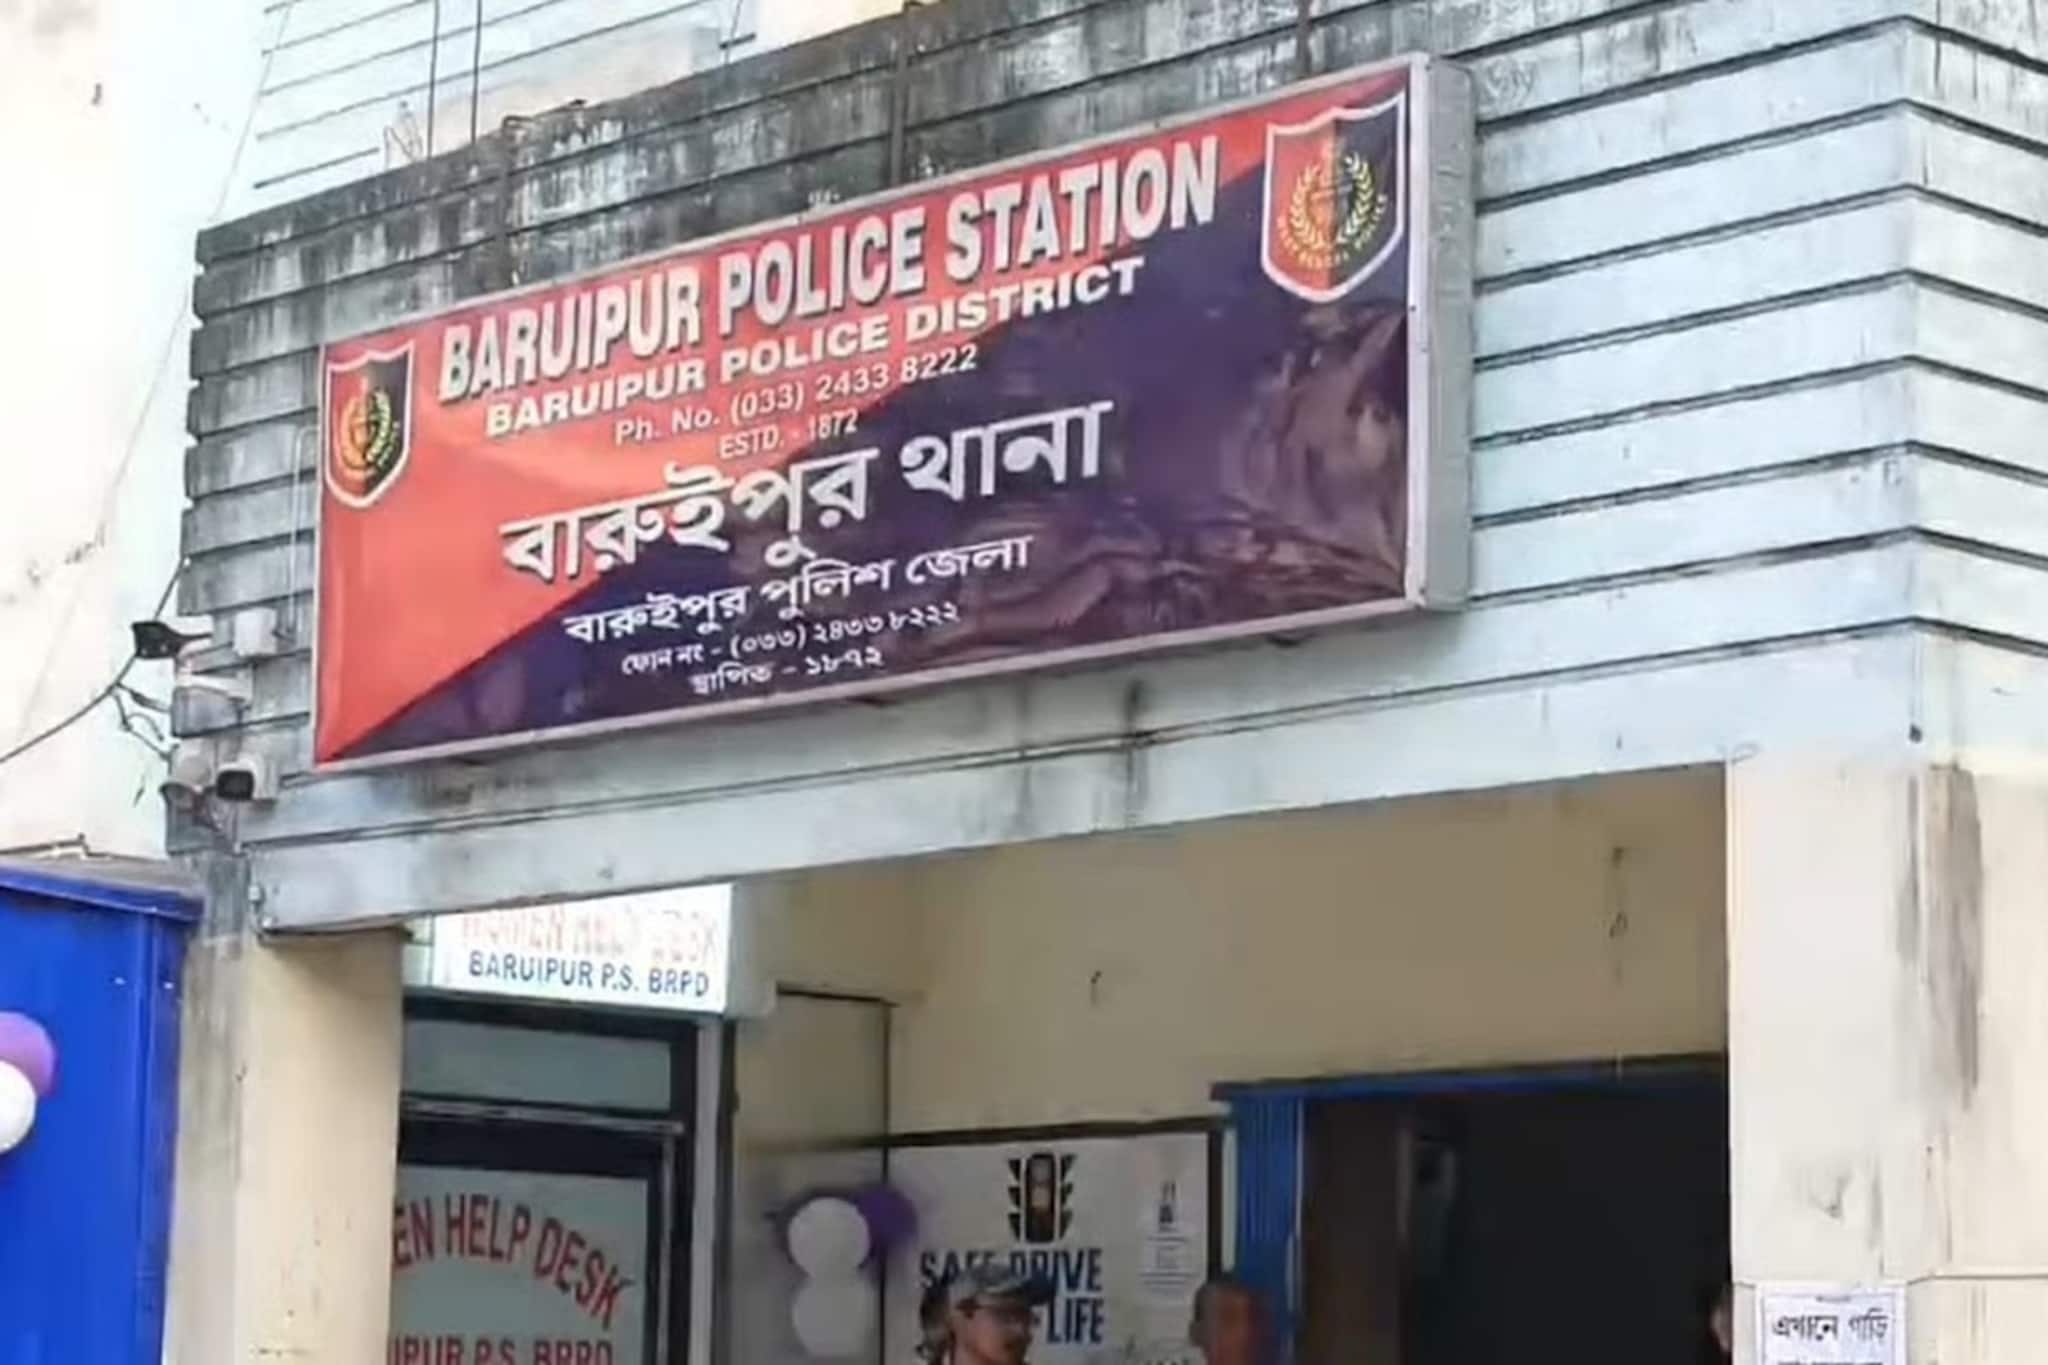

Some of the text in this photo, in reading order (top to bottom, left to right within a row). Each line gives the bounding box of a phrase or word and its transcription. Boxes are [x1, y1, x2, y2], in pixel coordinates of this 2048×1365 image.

[439, 266, 701, 402] BARUIPUR
[718, 208, 925, 336] POLICE
[945, 135, 1218, 281] STATION
[486, 258, 1145, 437] BARUIPUR POLICE DISTRICT
[614, 343, 978, 445] Ph. No. (033) 2433 8222
[719, 425, 784, 458] ESTD.
[807, 409, 859, 441] 1872
[499, 447, 880, 581] বারুইপুর
[899, 400, 1114, 500] থানা
[562, 535, 1035, 642] বারুইপুর পুলিশ জেলা
[621, 649, 672, 675] ফোন
[730, 624, 806, 659] (০৩৩)
[804, 646, 884, 675] ১৮৭২
[468, 949, 710, 997] BARUIPUR P.S. BRPD
[445, 1192, 532, 1264] HELP
[534, 1216, 635, 1331] DESK
[920, 1249, 998, 1289] SA
[1047, 1297, 1105, 1345] LIFE
[1772, 1314, 1838, 1341] এখানে
